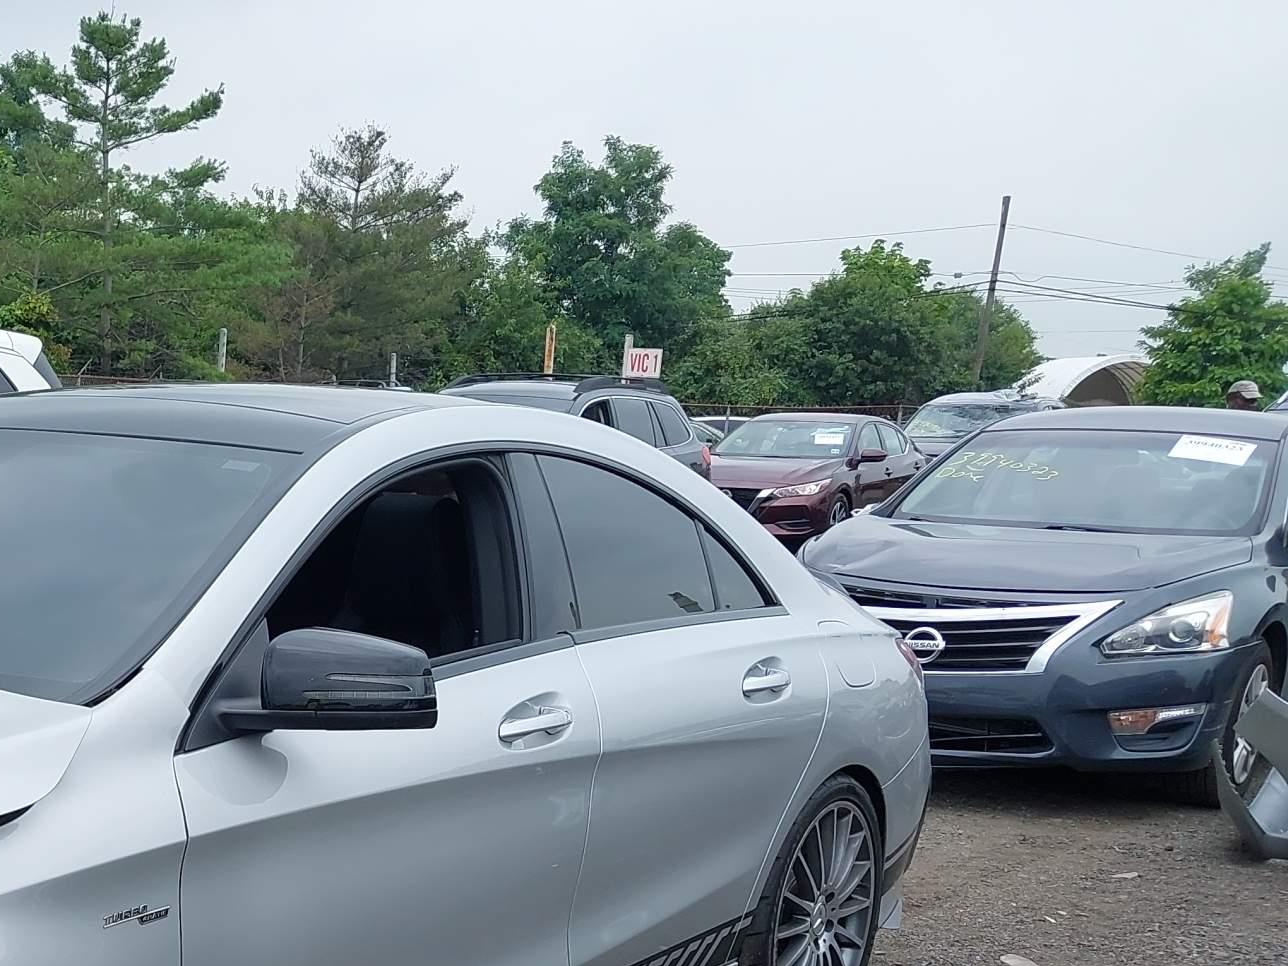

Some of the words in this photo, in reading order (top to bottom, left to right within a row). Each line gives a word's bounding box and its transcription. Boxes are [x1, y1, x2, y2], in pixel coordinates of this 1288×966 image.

[630, 353, 650, 373] VIC
[653, 354, 659, 374] 1
[103, 904, 149, 926] TURBO
